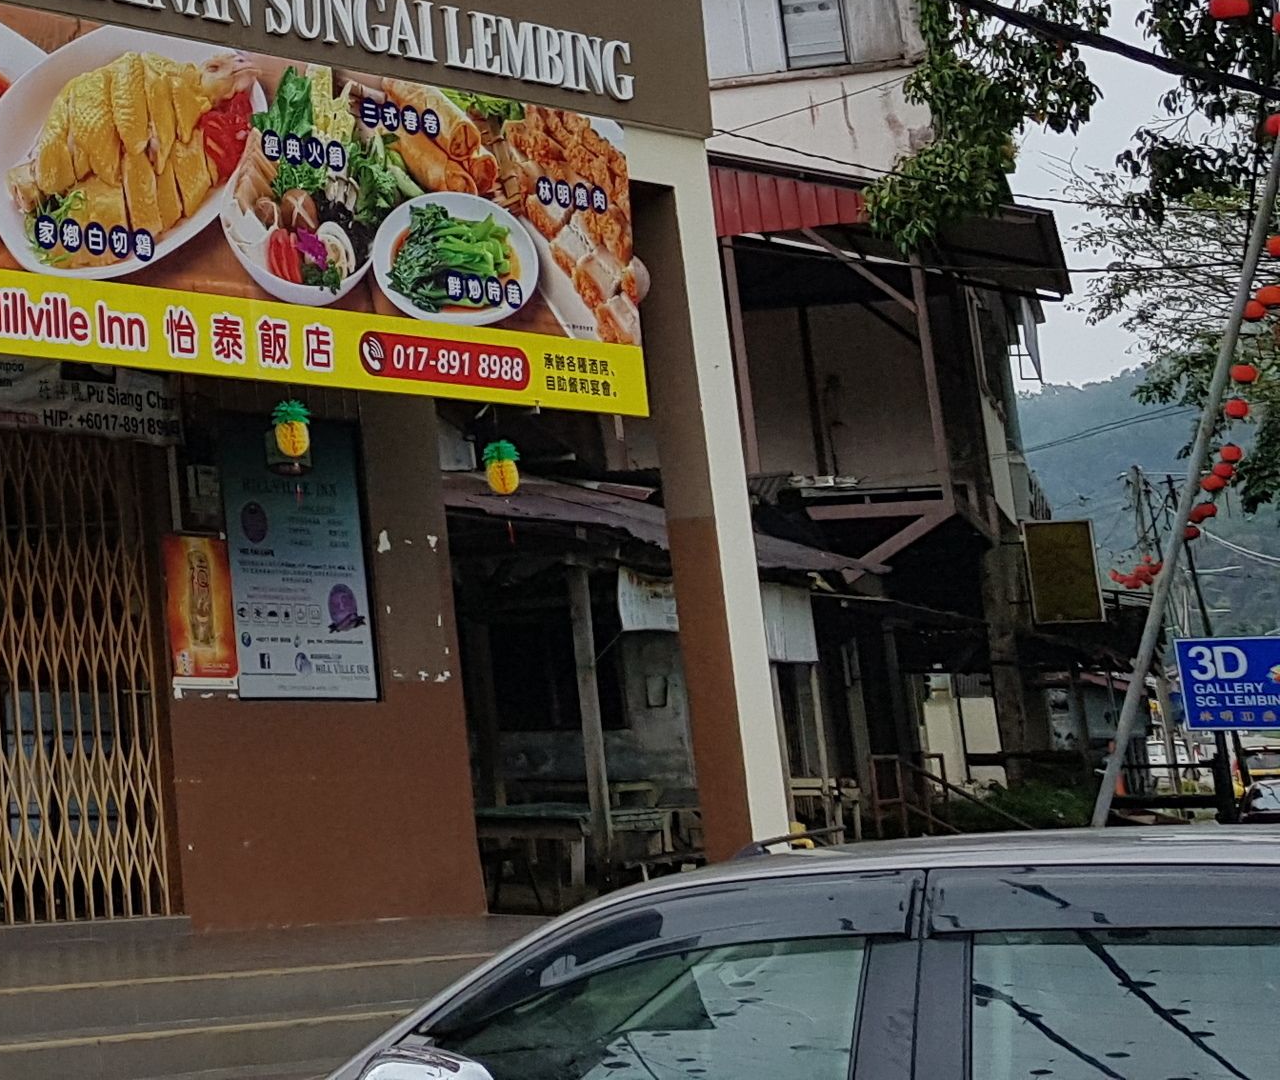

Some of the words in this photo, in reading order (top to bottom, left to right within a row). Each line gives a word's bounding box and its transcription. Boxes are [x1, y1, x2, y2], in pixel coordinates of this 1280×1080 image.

[440, 3, 636, 102] LEMBING
[97, 304, 146, 348] Inn
[166, 308, 332, 369] 怡泰飯店
[392, 343, 471, 377] 017-891
[478, 353, 524, 383] 8988
[86, 384, 104, 404] Pu
[107, 385, 143, 413] Siang
[1188, 645, 1249, 681] 3D
[1193, 682, 1265, 695] GALLERY
[1195, 695, 1222, 708] SG.
